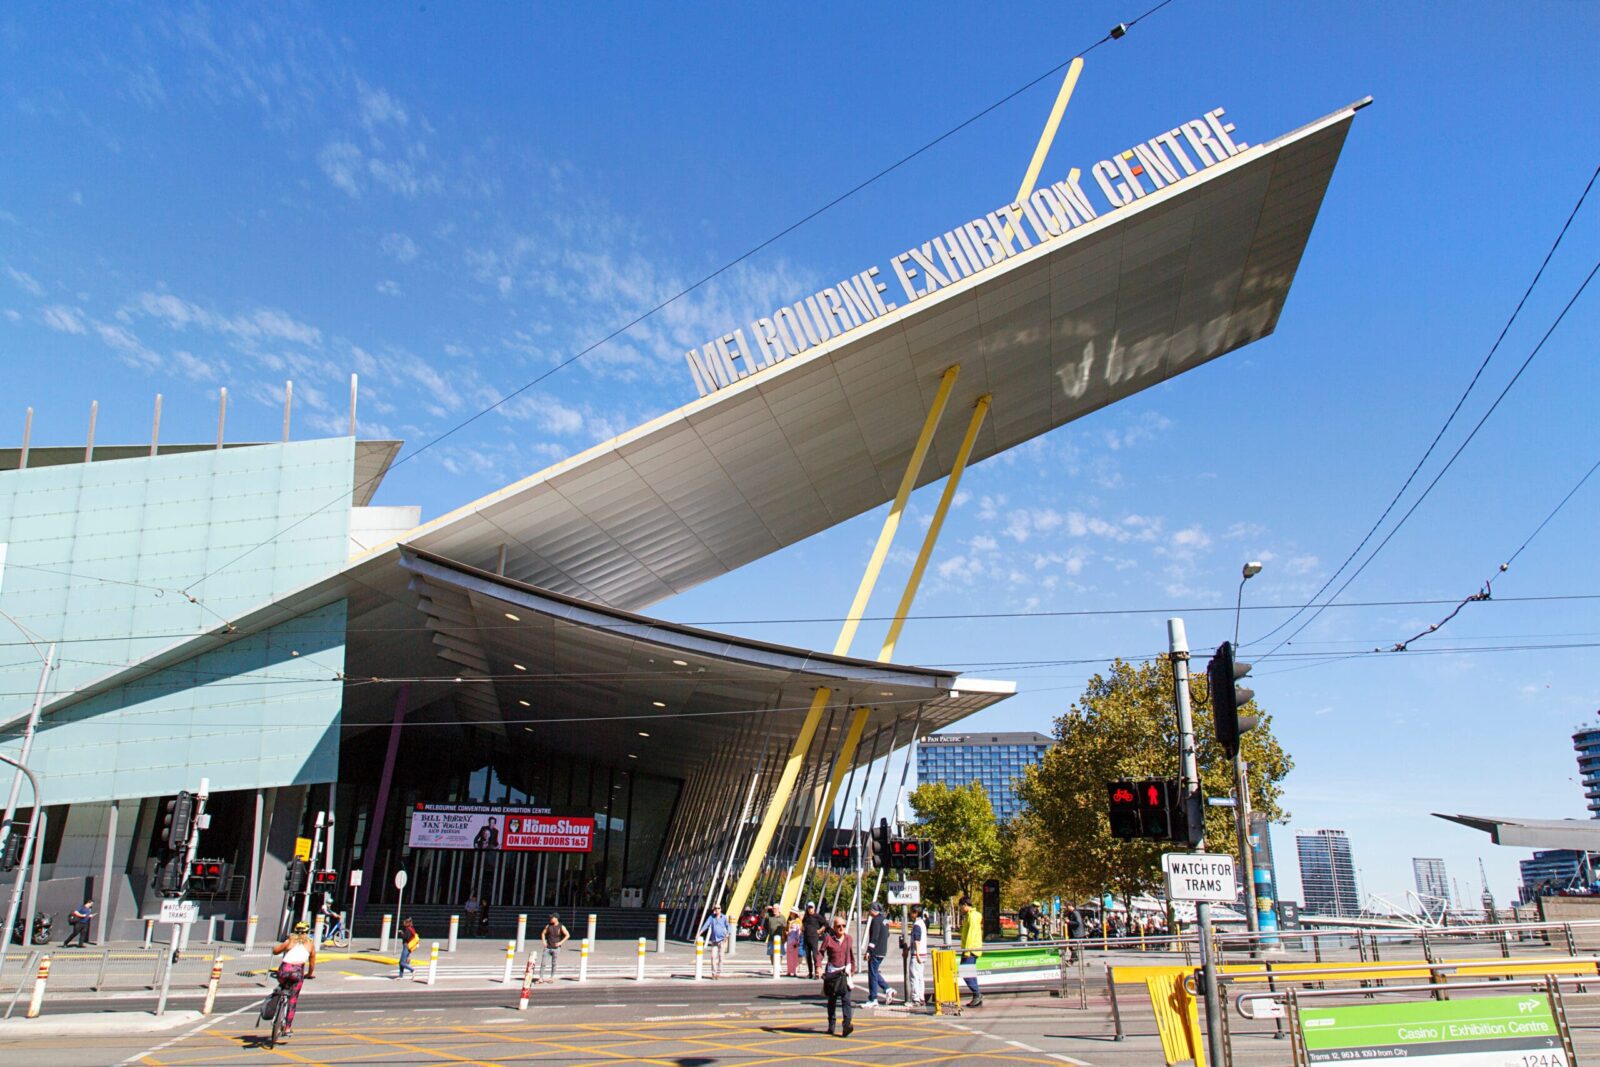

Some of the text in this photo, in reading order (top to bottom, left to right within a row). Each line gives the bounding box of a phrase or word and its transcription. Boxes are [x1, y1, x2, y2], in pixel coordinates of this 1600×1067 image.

[685, 107, 1248, 398] MELBOURNE EXHIBITION CENTRE
[508, 836, 586, 846] ON NOW: DOORS 1&5
[1172, 863, 1232, 876] WATCH FOR
[1186, 879, 1222, 892] TRAMS
[1398, 1028, 1438, 1040] Casino
[1450, 1024, 1506, 1037] Exhibition
[1508, 1021, 1549, 1033] Centre
[1394, 1048, 1408, 1057] City
[1522, 1054, 1563, 1067] 124A
